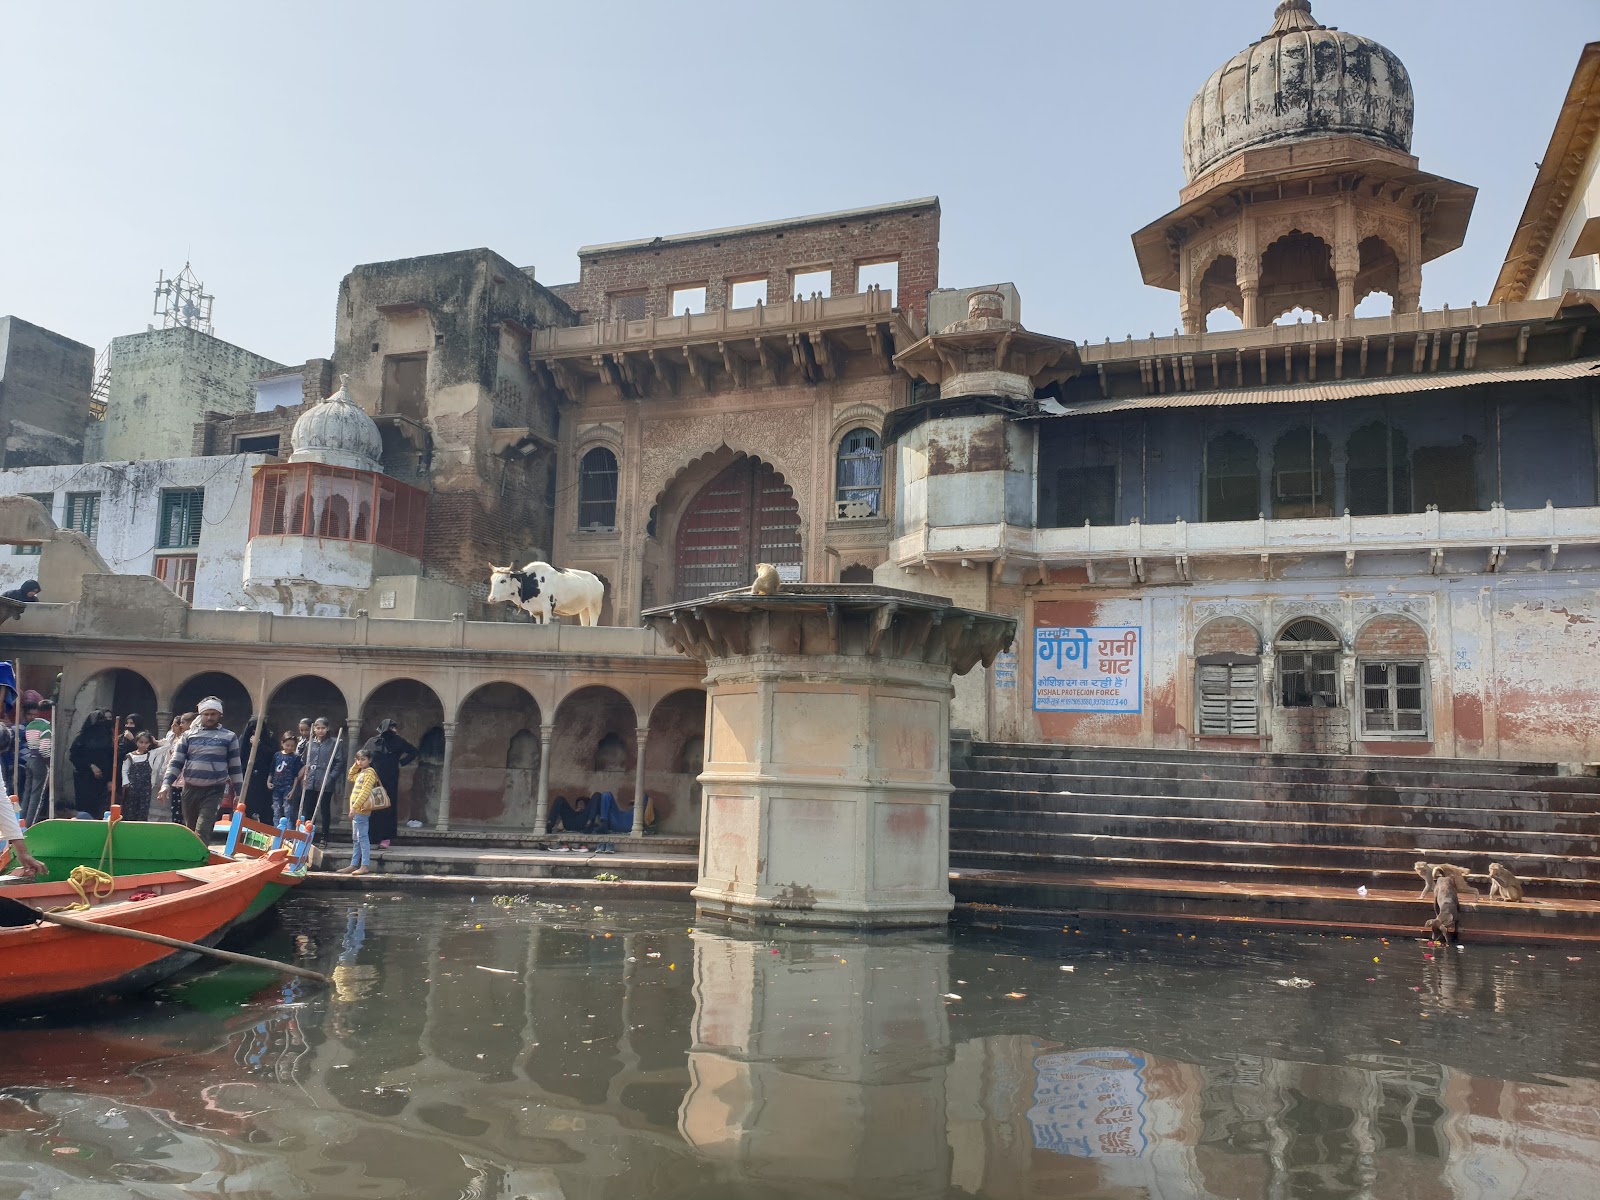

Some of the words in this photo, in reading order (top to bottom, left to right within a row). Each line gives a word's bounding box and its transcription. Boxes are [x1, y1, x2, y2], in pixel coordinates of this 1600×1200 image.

[1038, 628, 1070, 638] नमामि
[1098, 631, 1136, 656] रानी
[1098, 659, 1132, 674] घाट
[1038, 675, 1065, 687] कोशिश
[1065, 677, 1077, 687] रंग
[1079, 679, 1089, 687] ला
[1091, 676, 1112, 689] रही
